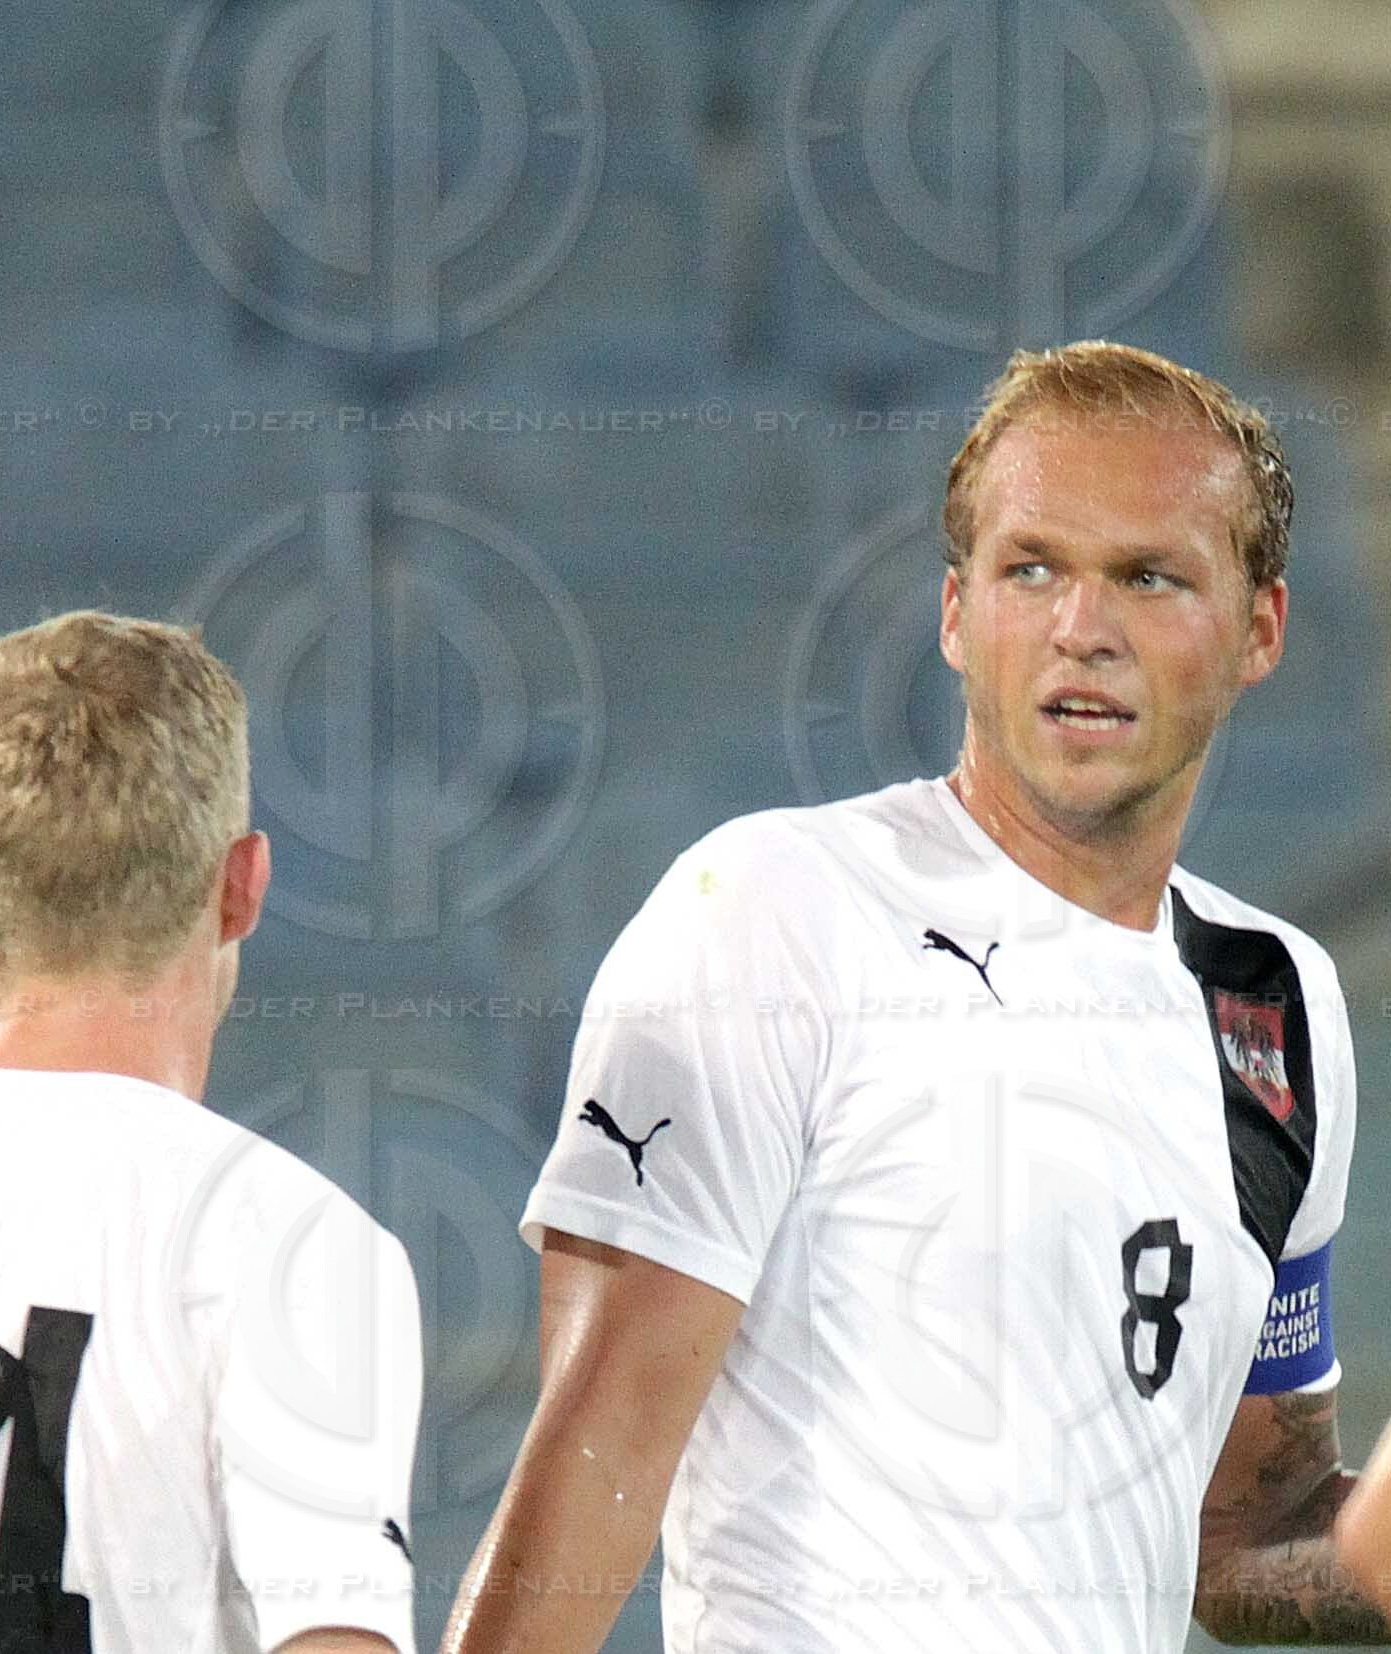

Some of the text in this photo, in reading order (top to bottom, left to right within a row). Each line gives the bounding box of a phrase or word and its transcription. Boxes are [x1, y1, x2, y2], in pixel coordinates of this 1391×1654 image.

[1121, 1217, 1193, 1400] 8
[1269, 1283, 1320, 1317] NITE
[1258, 1307, 1319, 1340] GAINST
